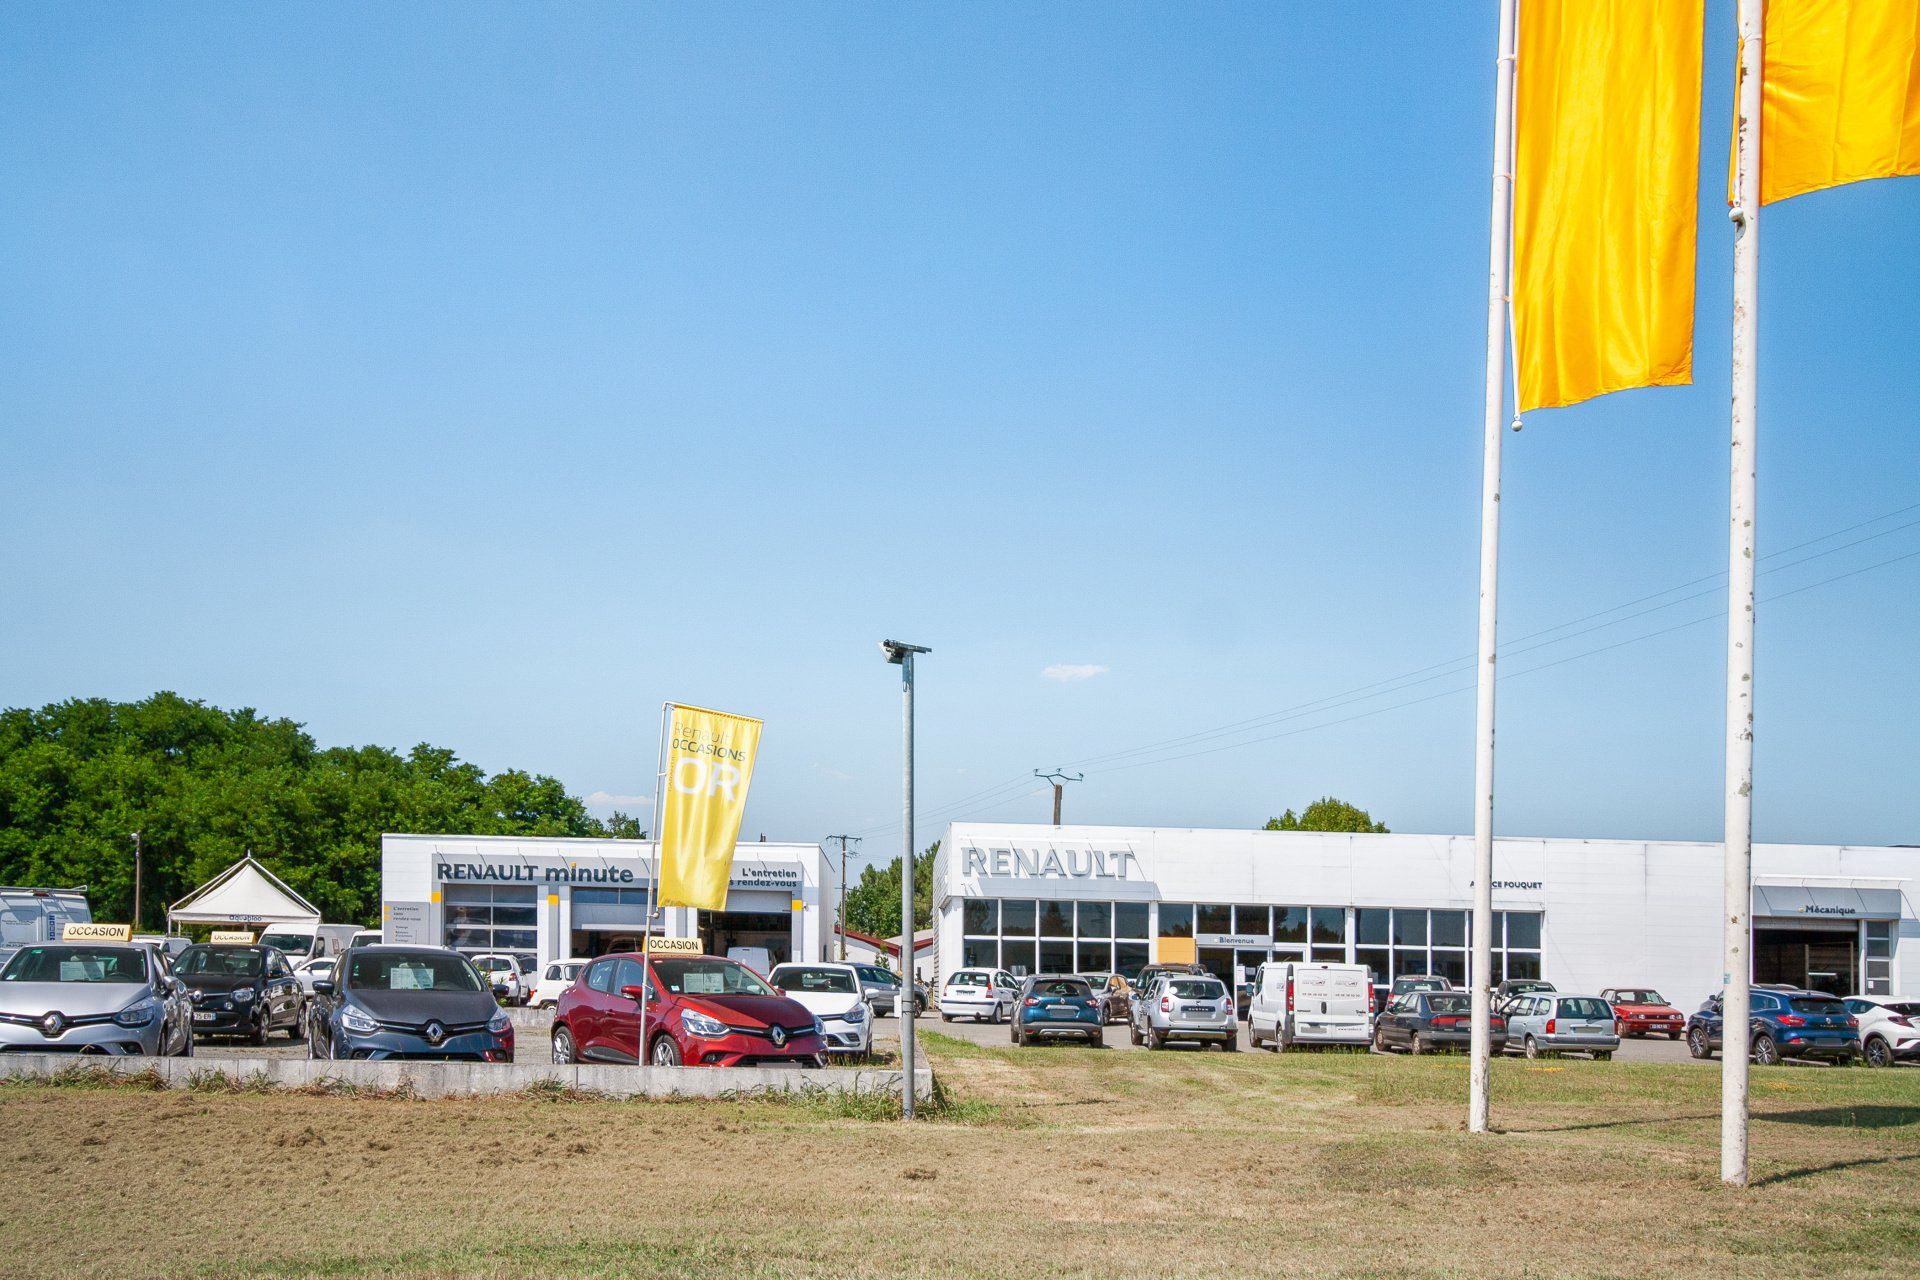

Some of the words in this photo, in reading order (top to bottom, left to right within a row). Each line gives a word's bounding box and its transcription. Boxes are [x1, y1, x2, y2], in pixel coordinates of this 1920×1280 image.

[672, 738, 746, 761] OCCASIONS
[674, 757, 741, 803] OR
[960, 847, 1137, 879] RENAULT
[437, 863, 538, 881] RENAULT
[545, 861, 634, 883] minute
[742, 868, 797, 878] L'entretien
[737, 878, 797, 888] rendez-vous
[1503, 881, 1543, 890] FOUQUET
[1805, 904, 1856, 916] Mécanique
[68, 926, 125, 937] OCCASION
[650, 940, 699, 950] OCCASION
[1219, 936, 1255, 944] Bienvenue
